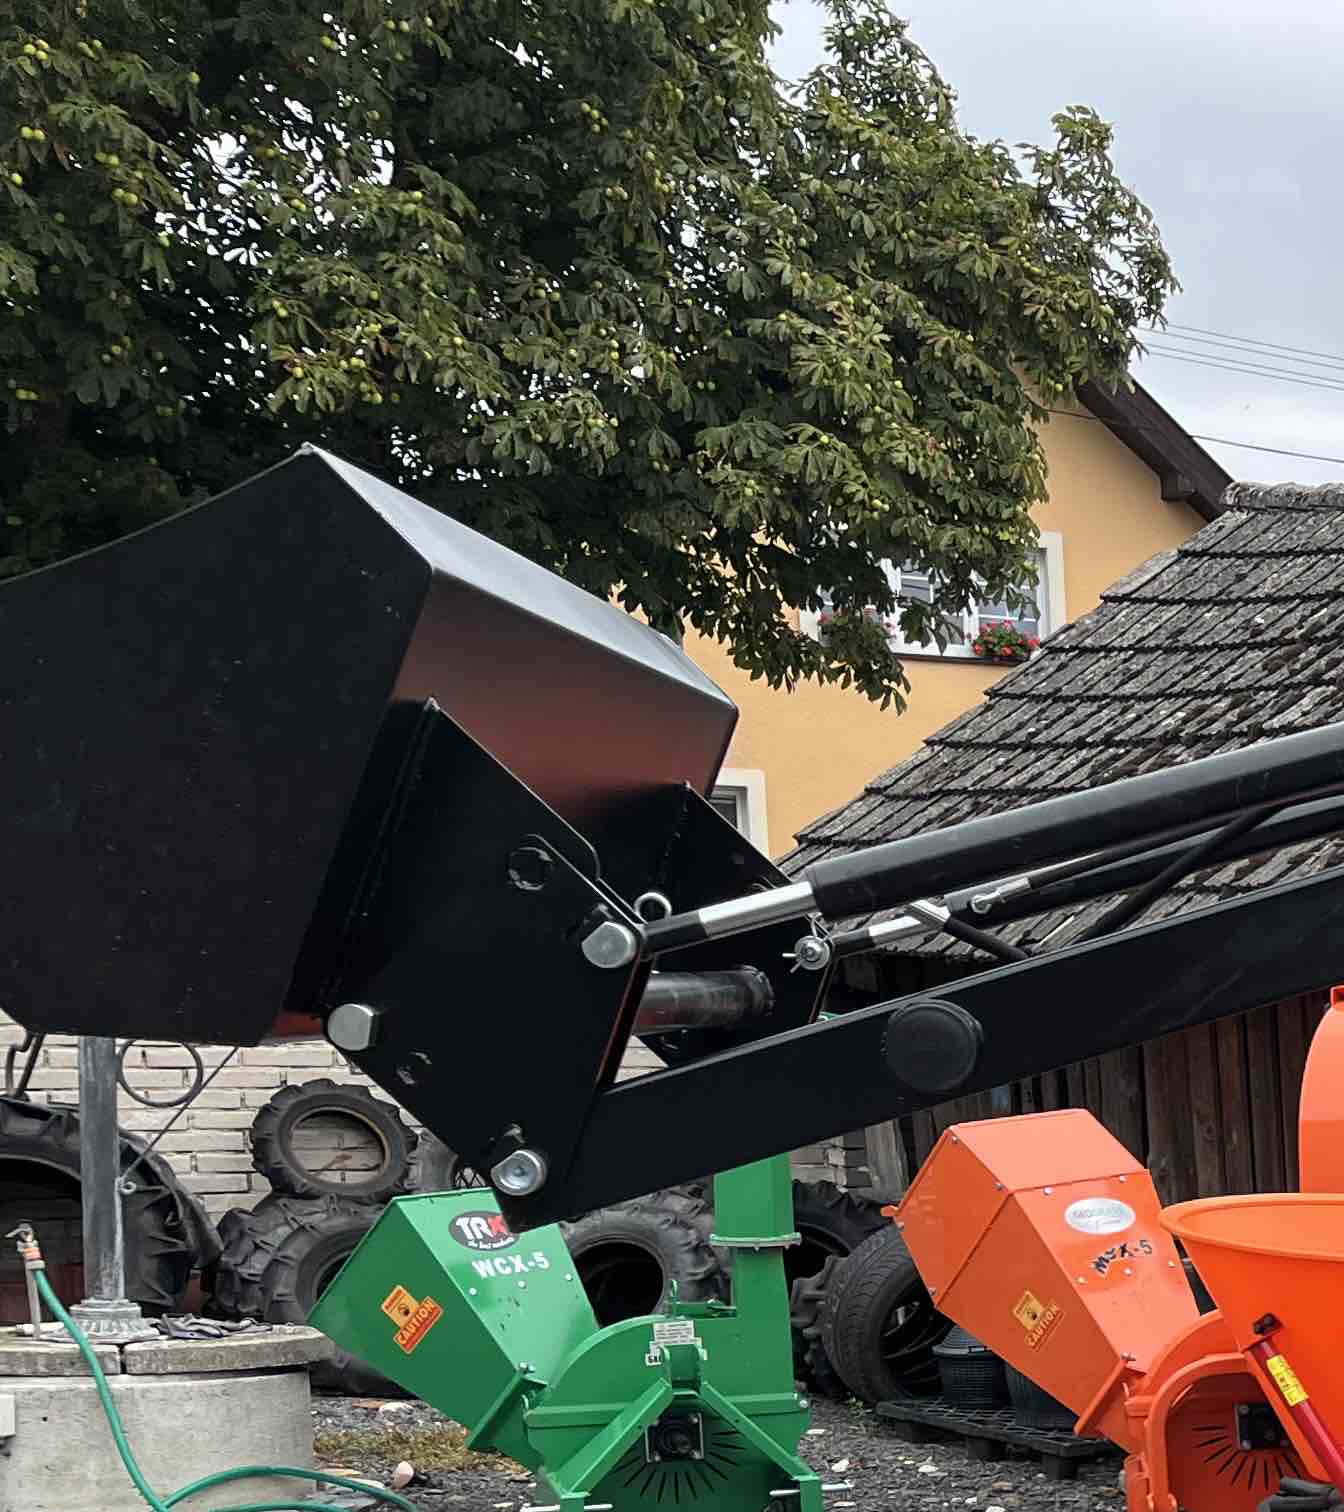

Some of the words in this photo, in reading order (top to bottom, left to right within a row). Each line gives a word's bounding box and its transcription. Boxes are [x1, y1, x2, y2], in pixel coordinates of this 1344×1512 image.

[471, 1251, 550, 1280] WCX-5
[398, 1299, 435, 1344] CAUTION
[1026, 1302, 1059, 1347] CAUTION
